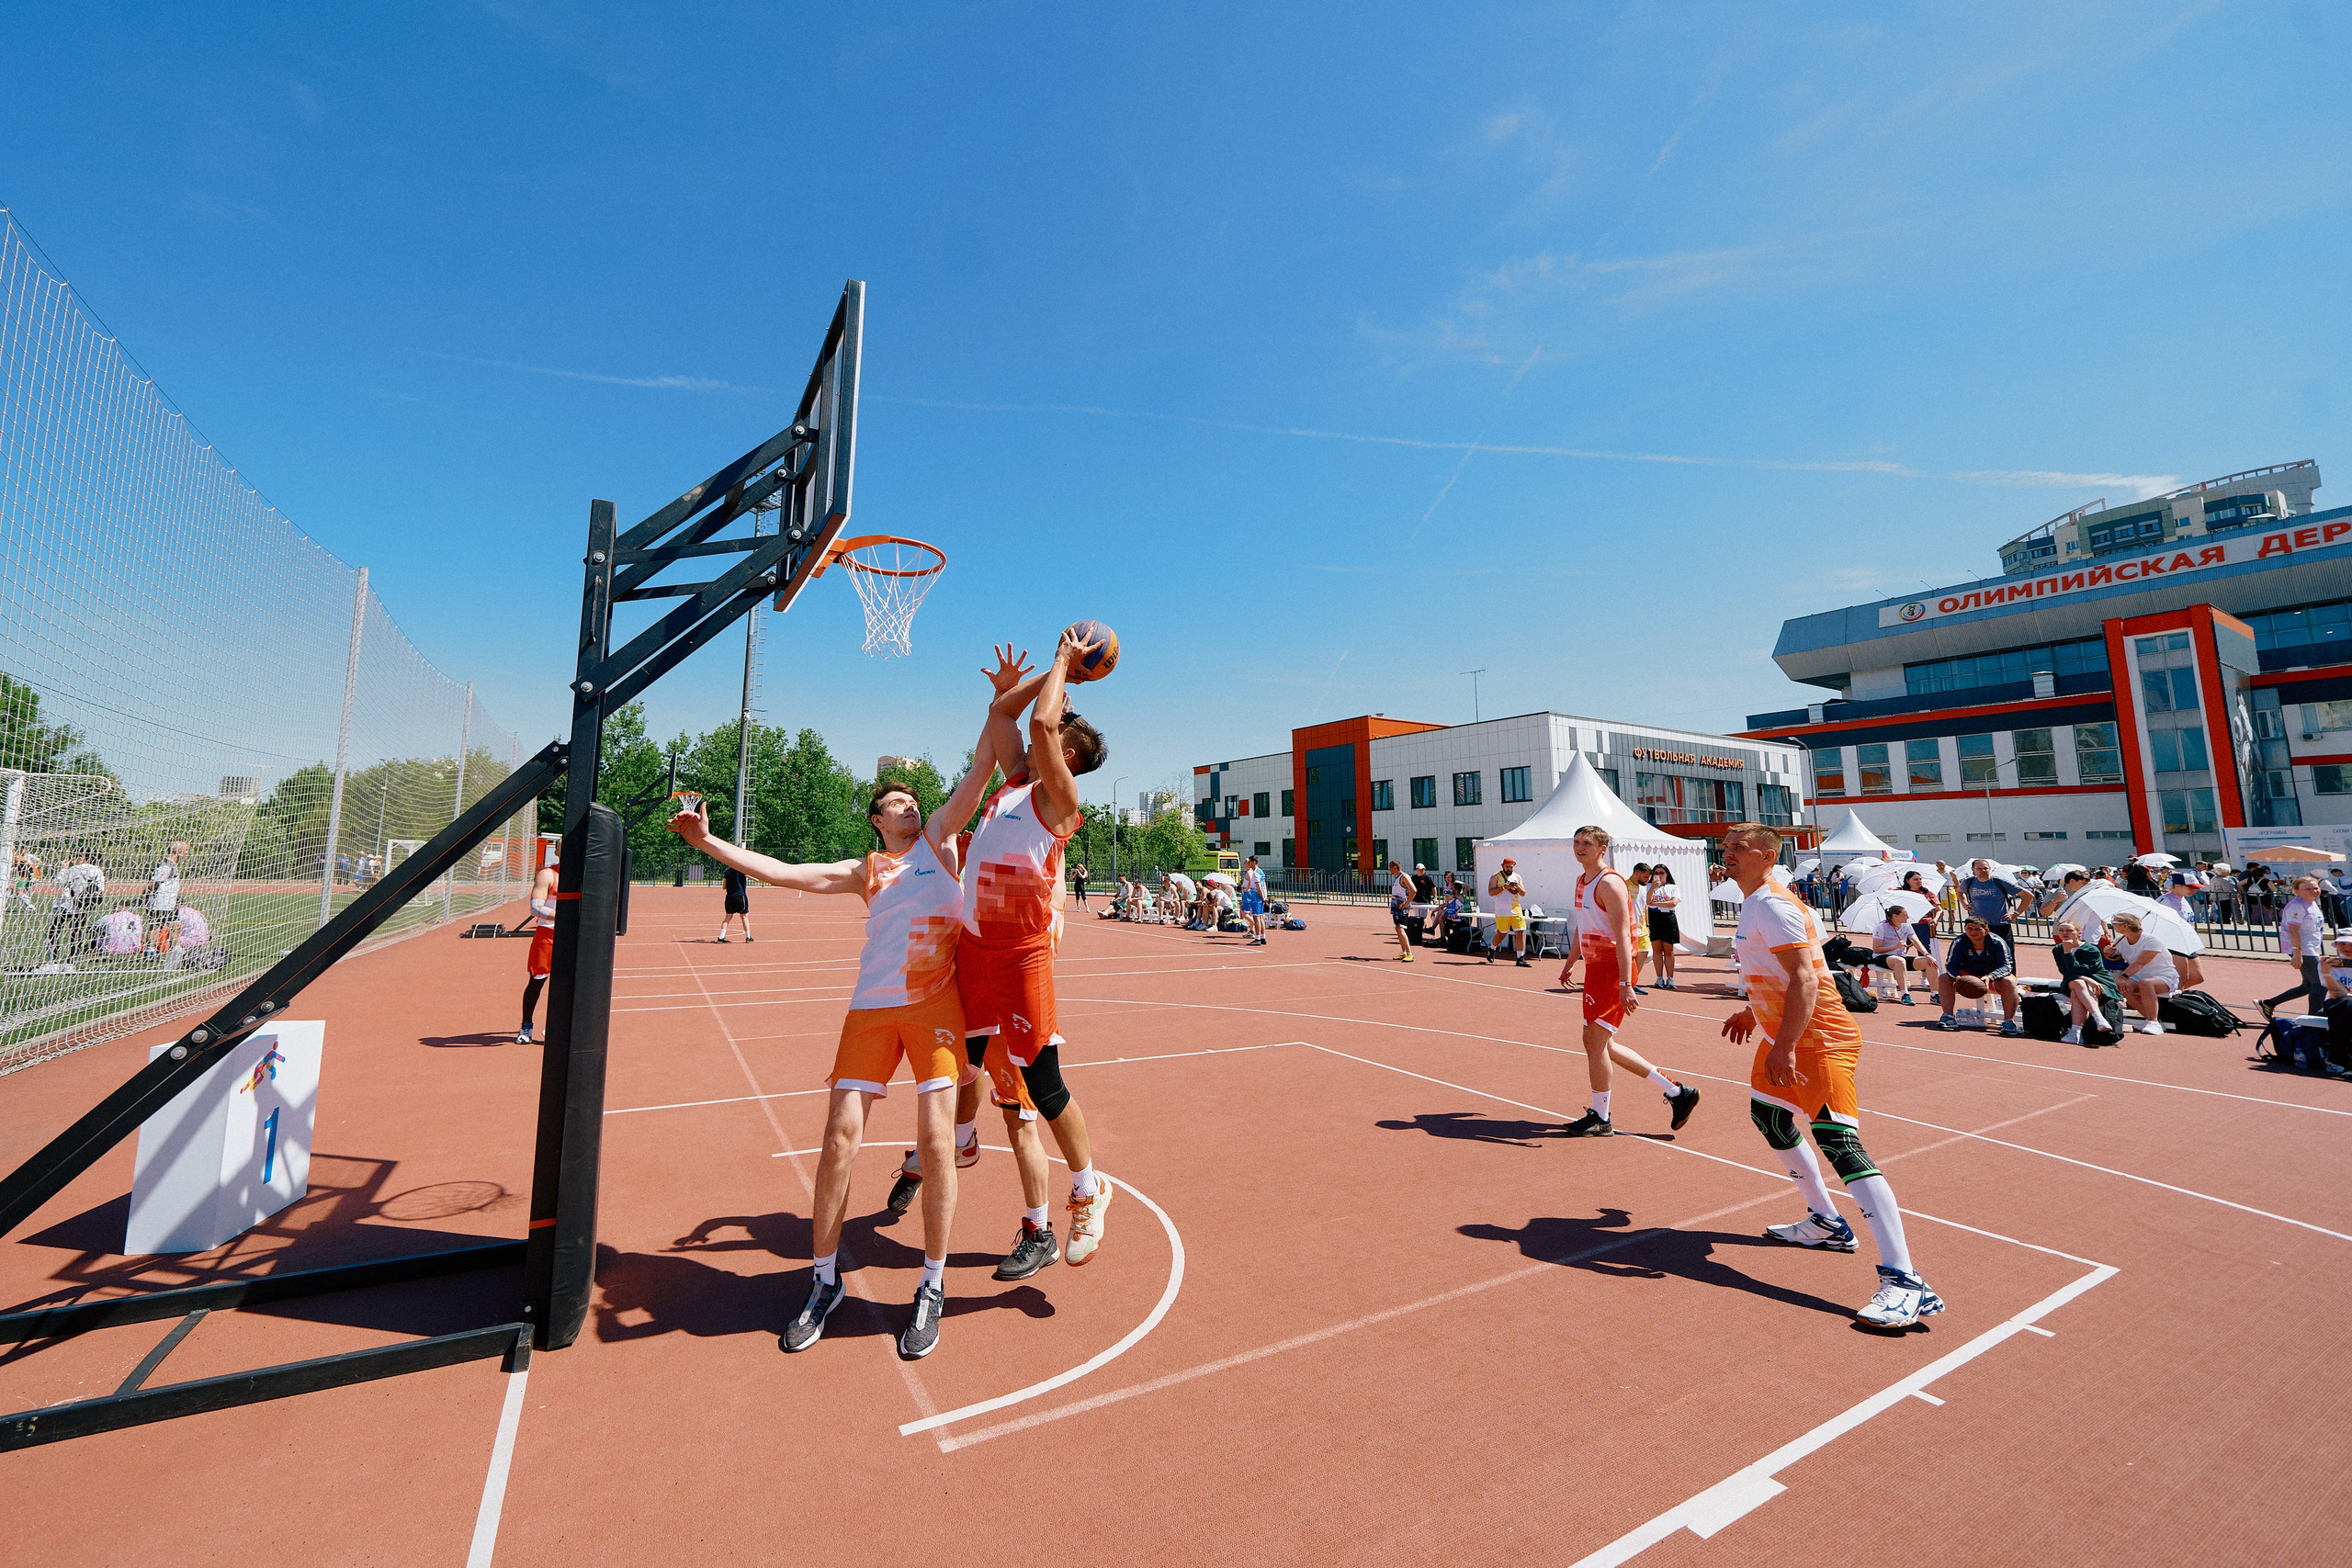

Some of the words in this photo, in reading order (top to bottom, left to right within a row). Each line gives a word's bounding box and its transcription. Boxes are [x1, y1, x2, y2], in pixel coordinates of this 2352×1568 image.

[1938, 546, 2225, 614] ОЛИМПИЙСКАЯ
[2257, 522, 2352, 558] ДЕР
[1633, 747, 1696, 764] ФУТБОЛЬНАЯ
[1700, 754, 1745, 770] АКАДЕМИЯ
[264, 1106, 279, 1184] 1
